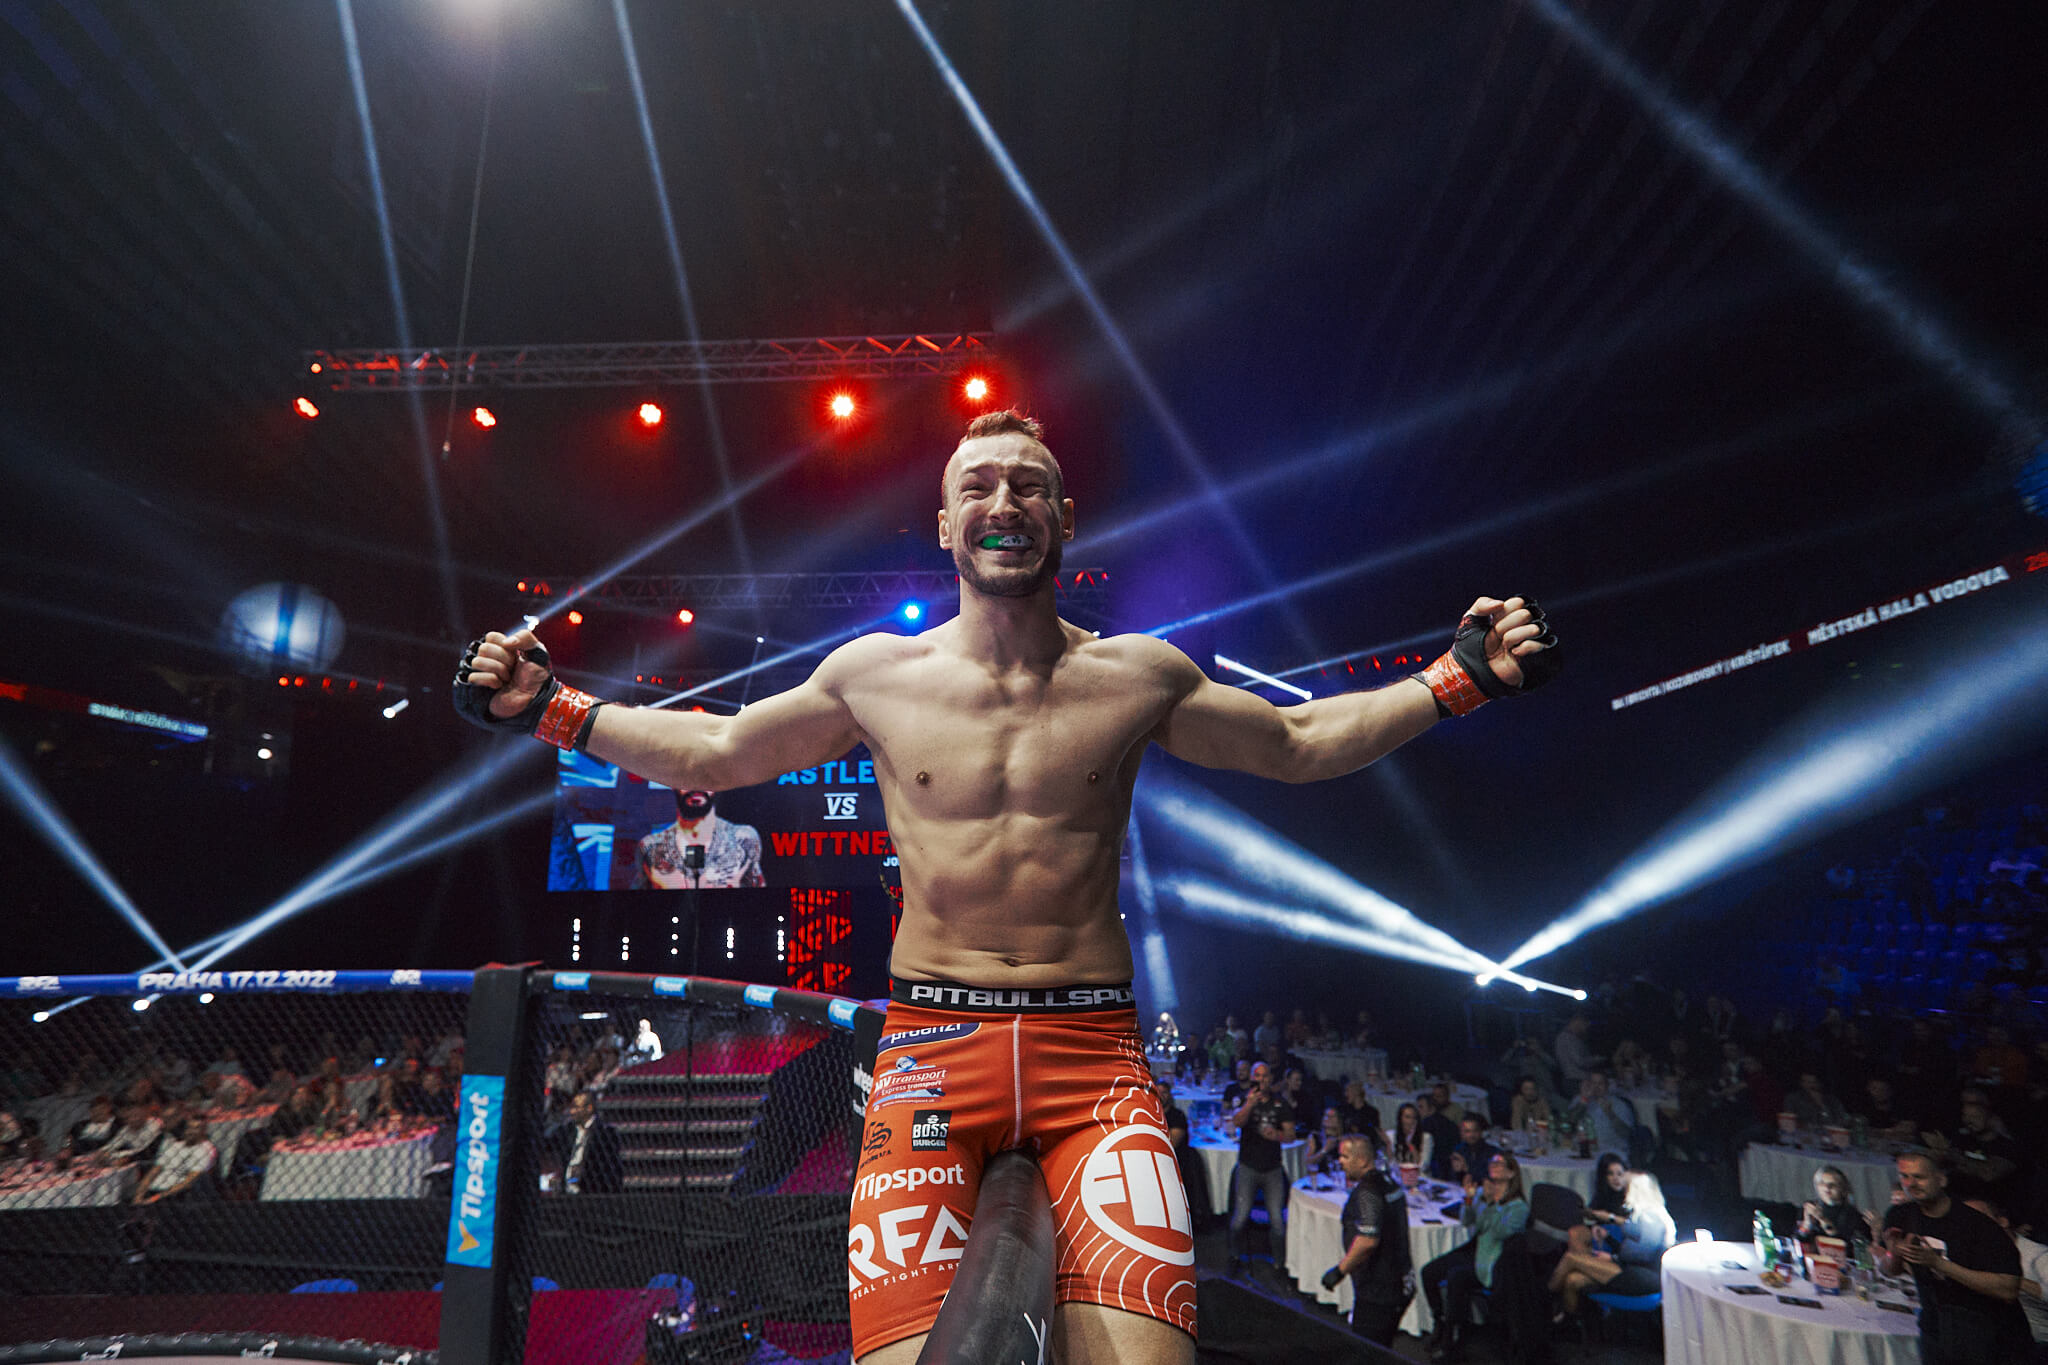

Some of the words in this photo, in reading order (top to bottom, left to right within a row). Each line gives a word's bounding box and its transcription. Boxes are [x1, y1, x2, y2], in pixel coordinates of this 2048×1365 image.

[1878, 593, 1929, 622] HALA
[826, 796, 857, 816] VS
[771, 831, 897, 857] WITTNE
[882, 856, 900, 868] JO
[138, 972, 224, 991] PRAHA
[228, 970, 337, 989] 17.12.2022
[910, 985, 1135, 1007] PITBULLSPO
[881, 1084, 906, 1097] Express
[907, 1080, 942, 1090] transport
[912, 1123, 949, 1139] BOSS
[912, 1139, 946, 1147] BURGER
[460, 1092, 490, 1219] Tipsport
[859, 1163, 965, 1202] Tipsport
[848, 1203, 969, 1293] RFA
[883, 1266, 928, 1287] FIGHT
